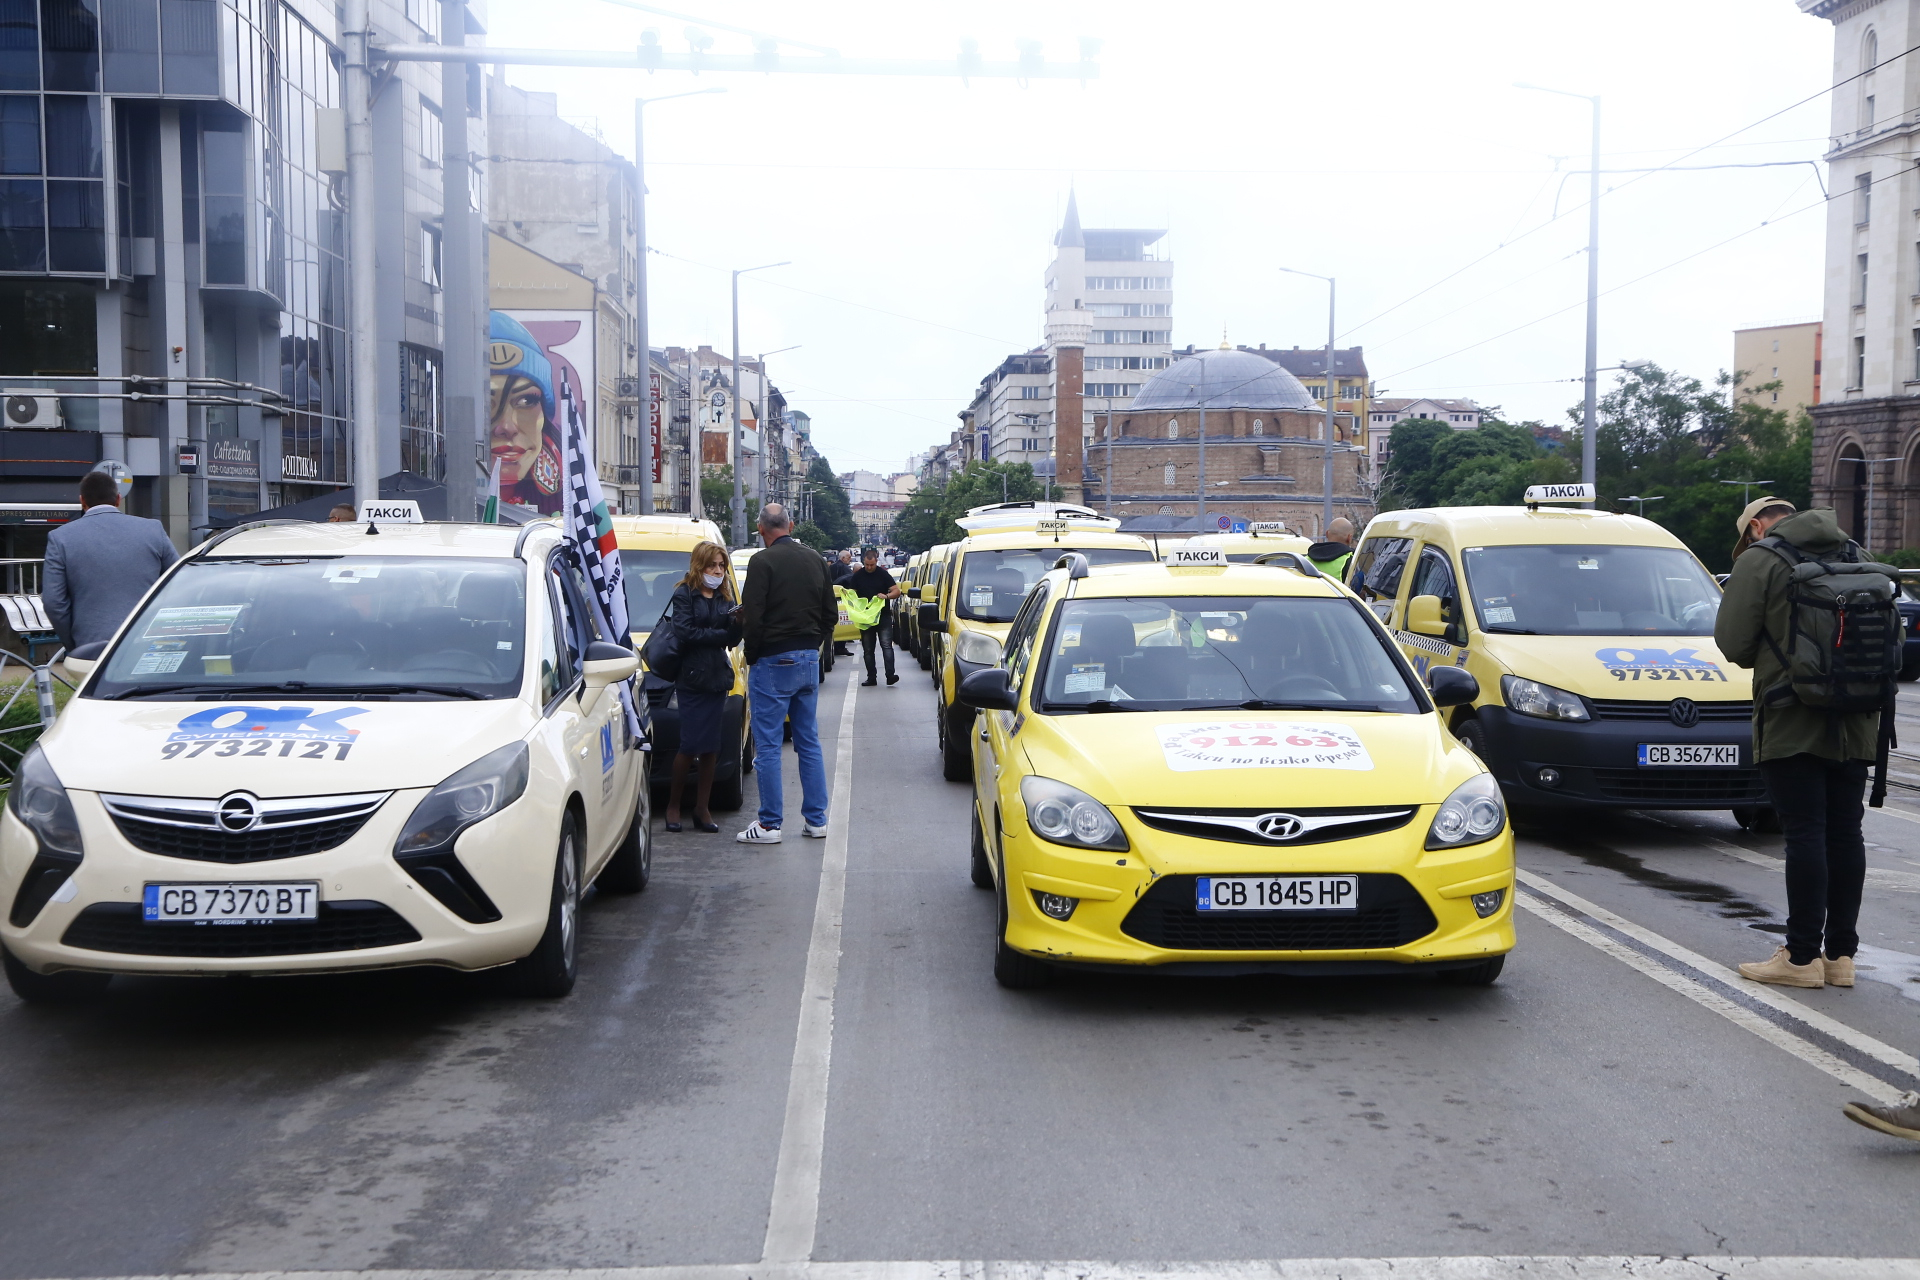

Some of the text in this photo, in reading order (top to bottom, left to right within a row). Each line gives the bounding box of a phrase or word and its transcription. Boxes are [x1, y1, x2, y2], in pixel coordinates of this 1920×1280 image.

[213, 440, 251, 461] Caffetteria
[284, 454, 315, 477] ОПТИКА
[1542, 485, 1585, 498] ТАКСИ
[365, 507, 412, 518] ТАКСИ
[1175, 551, 1219, 562] ТАКСИ
[1610, 668, 1728, 682] 9732121
[172, 732, 350, 742] СУПЕРТРАНС
[1163, 726, 1222, 749] радио
[1287, 726, 1362, 749] такси
[160, 738, 353, 761] 9732121
[1174, 748, 1361, 765] Такси по всяко време
[1649, 747, 1670, 763] CB
[1674, 747, 1712, 763] 3567
[1715, 747, 1736, 763] KH
[1198, 880, 1352, 906] BG CB 1845 HP
[145, 888, 312, 916] BG CB 7370 BT
